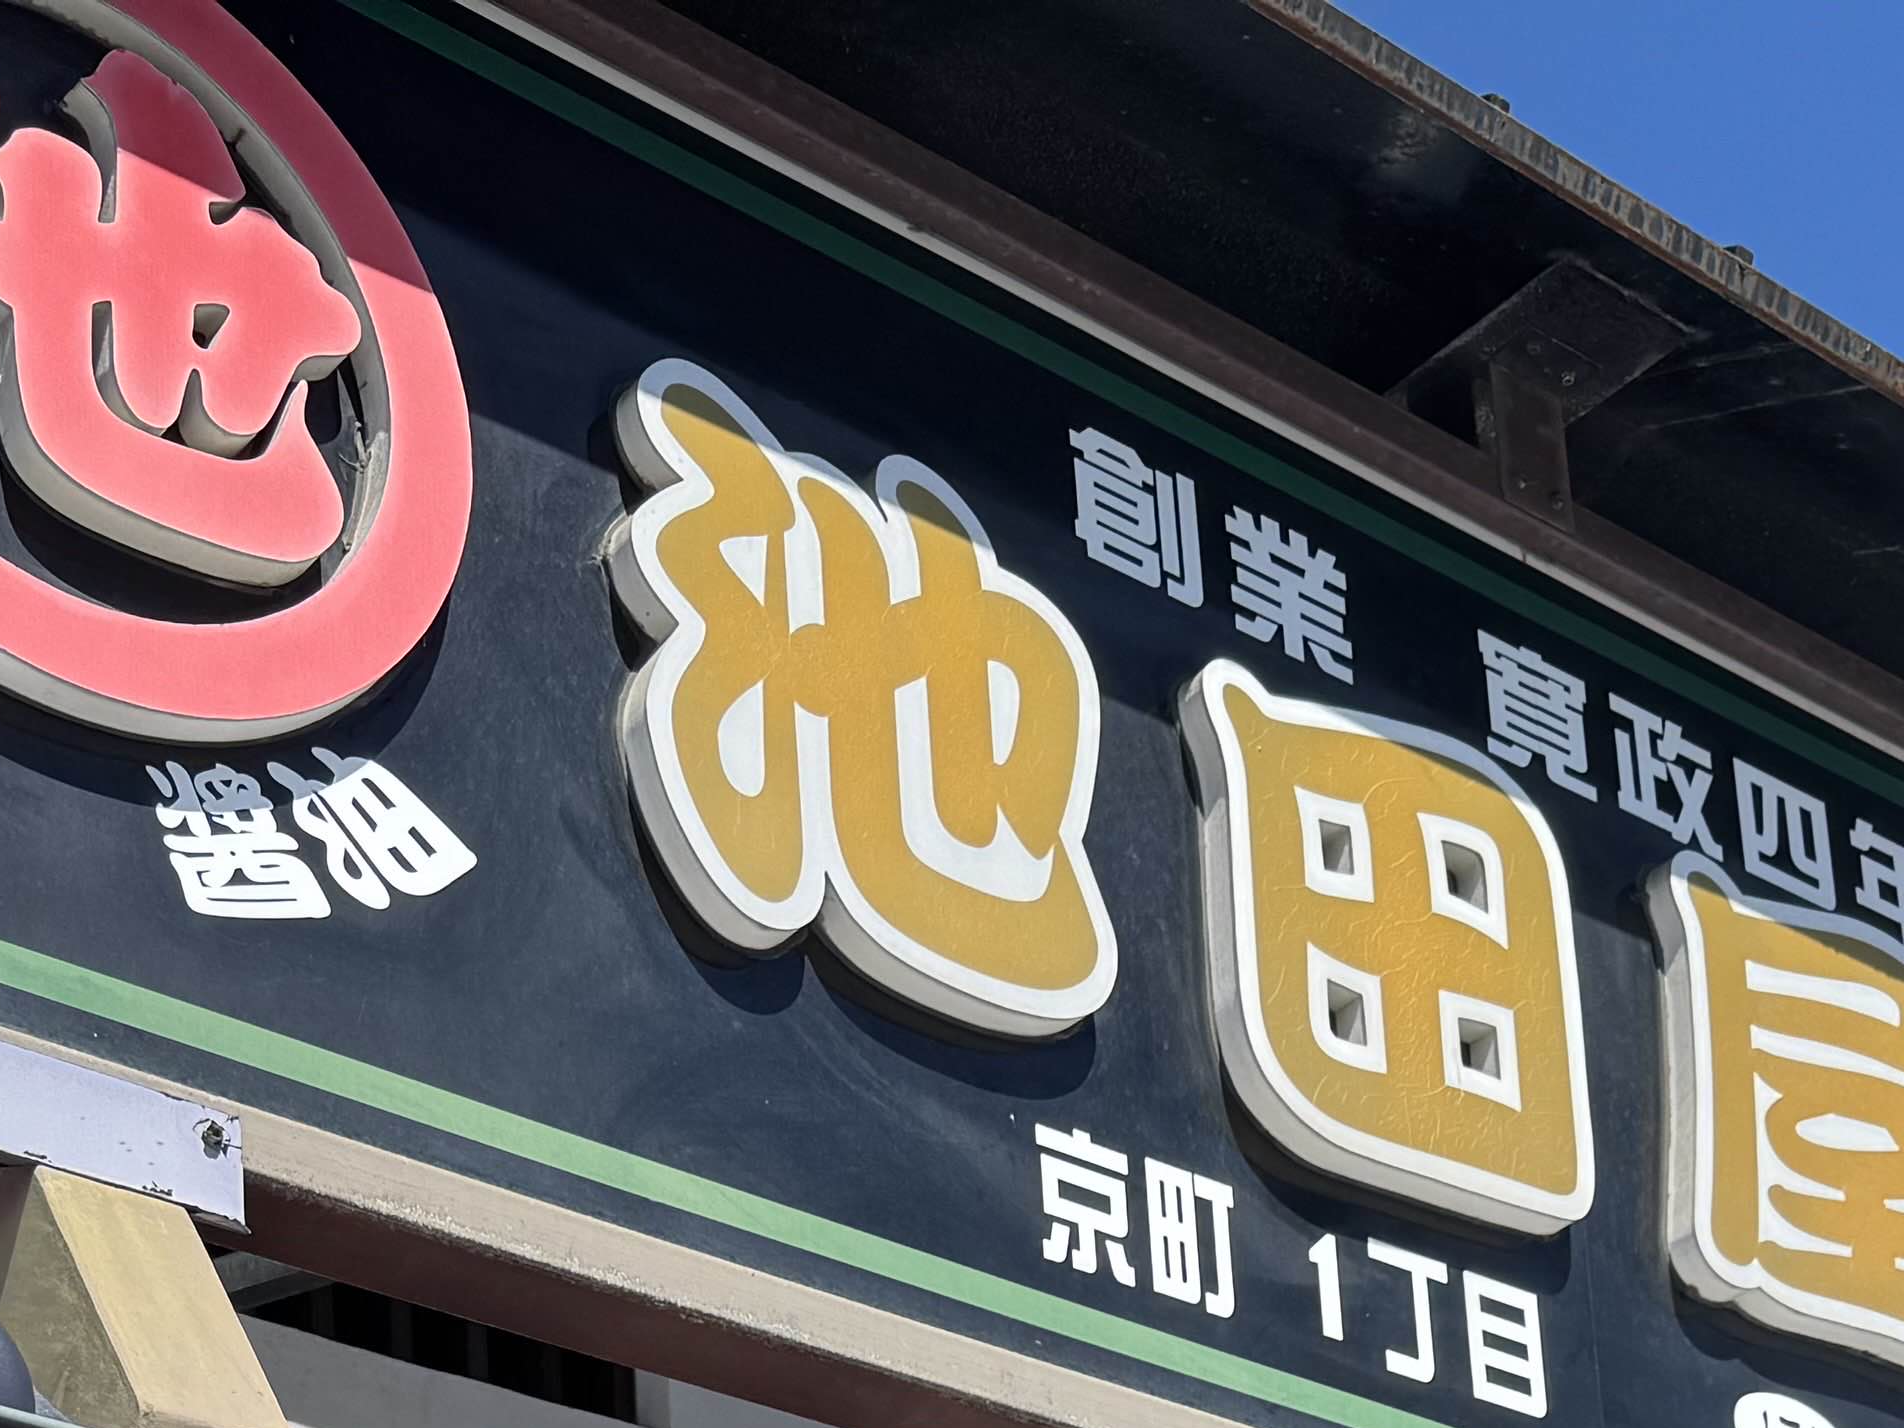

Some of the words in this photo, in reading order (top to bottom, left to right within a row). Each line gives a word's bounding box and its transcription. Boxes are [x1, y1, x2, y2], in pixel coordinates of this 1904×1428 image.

[1069, 428, 1355, 685] 創業
[1033, 1122, 1236, 1318] 京町
[1307, 1231, 1549, 1418] 1丁目
